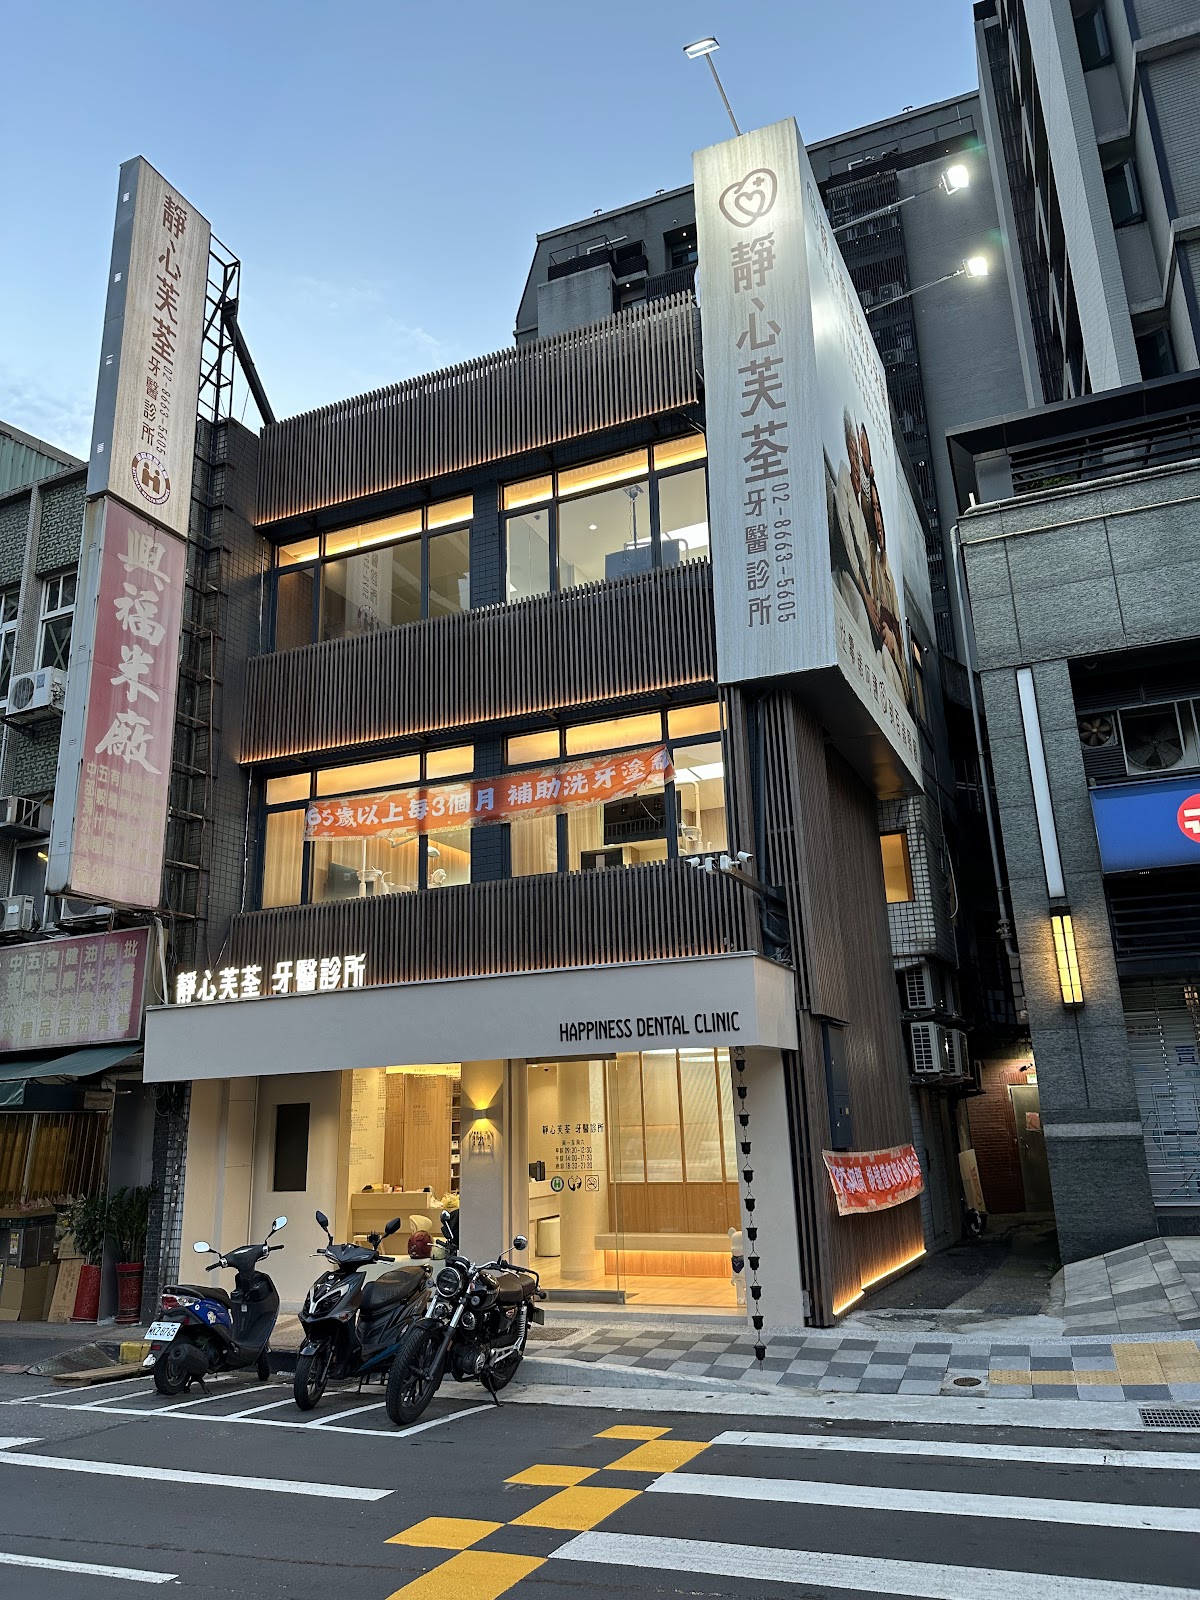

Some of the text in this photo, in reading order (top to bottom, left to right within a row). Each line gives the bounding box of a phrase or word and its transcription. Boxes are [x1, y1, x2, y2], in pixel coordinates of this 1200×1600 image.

[152, 195, 188, 366] 靜心芙荃
[141, 355, 161, 447] 牙醫診所
[156, 364, 173, 456] 02-8663-5605
[731, 231, 789, 483] 靜心芙荃
[743, 488, 772, 627] 牙醫診所
[771, 482, 796, 623] 02-8663-5605
[95, 528, 171, 774] 興福米廠
[307, 787, 494, 827] 65歲以上每3個月
[176, 953, 366, 1004] 靜心芙荃 牙醫診所
[559, 1011, 741, 1042] HAPPINESS DENTAL CLINIC
